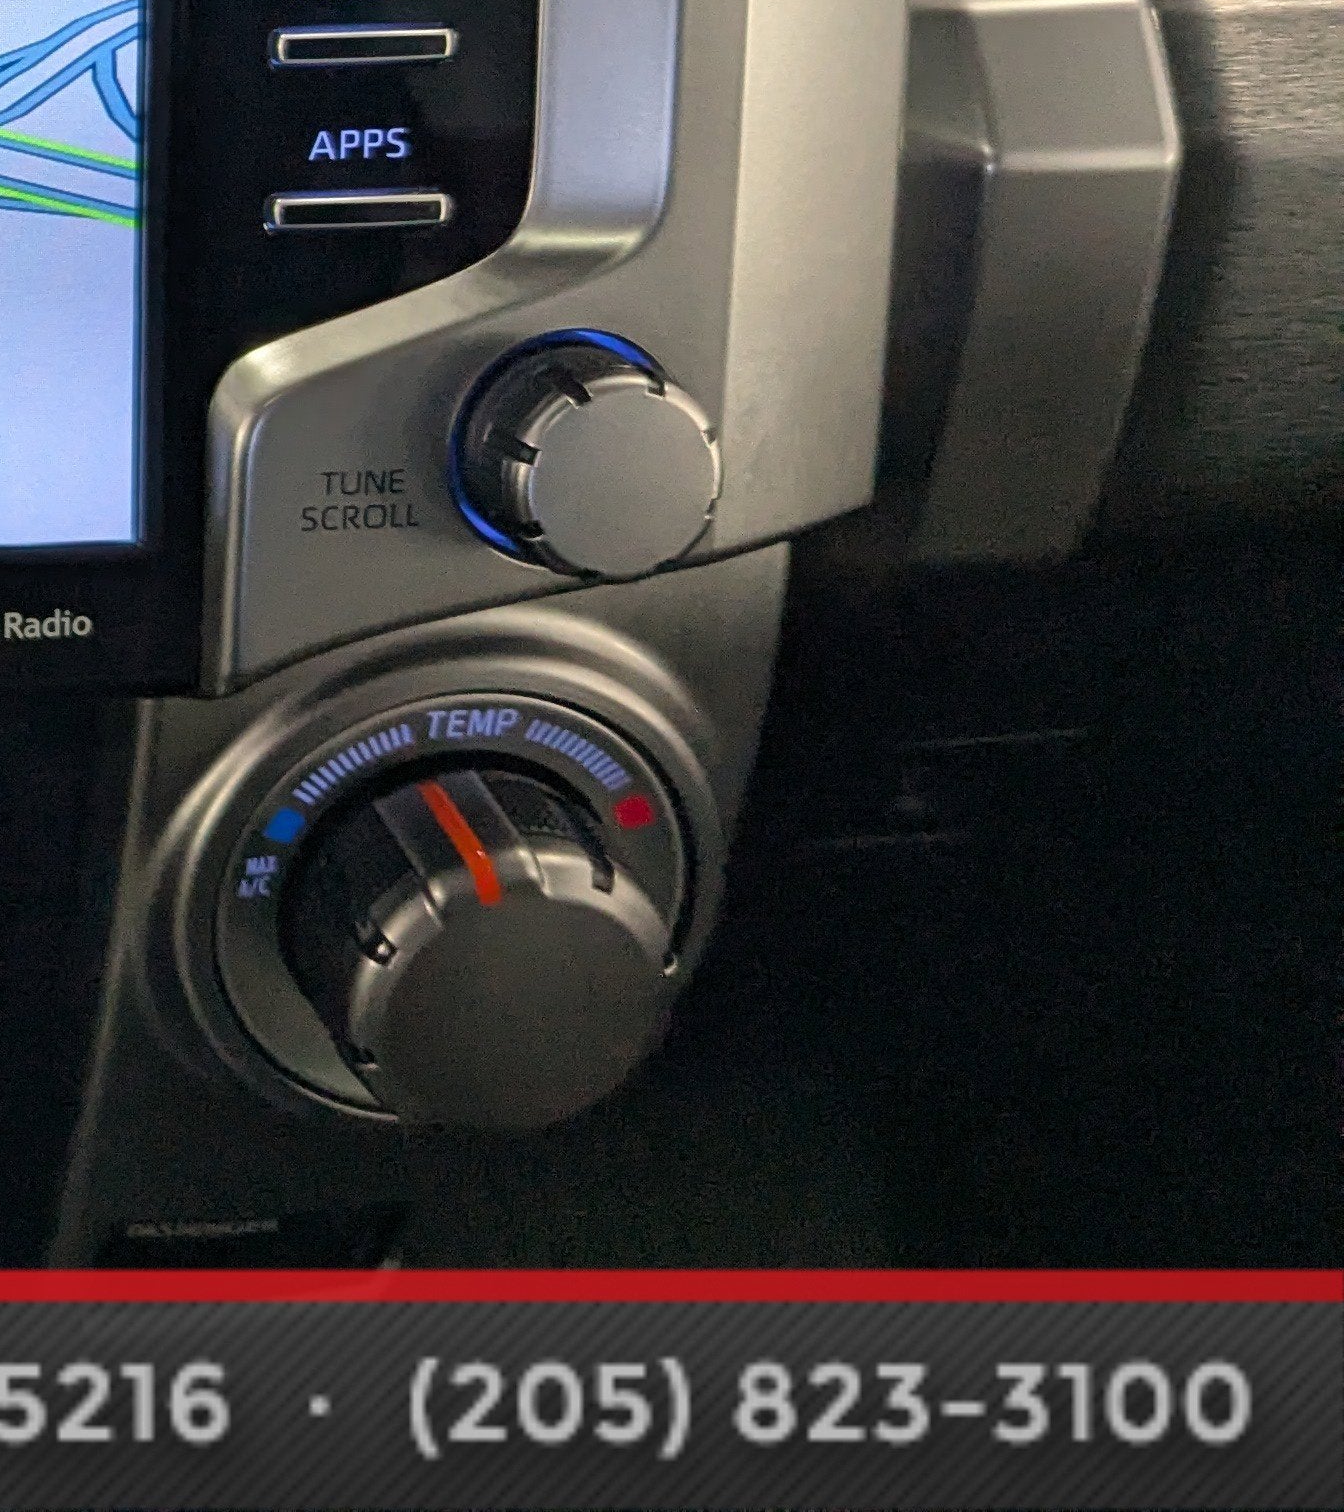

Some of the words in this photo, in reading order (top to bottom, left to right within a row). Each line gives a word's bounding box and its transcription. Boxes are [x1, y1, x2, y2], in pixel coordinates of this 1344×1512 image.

[309, 128, 411, 161] APPS
[320, 468, 406, 496] TUNE
[300, 503, 420, 532] SCROLL
[4, 608, 93, 640] Radio
[426, 707, 521, 741] TEMP
